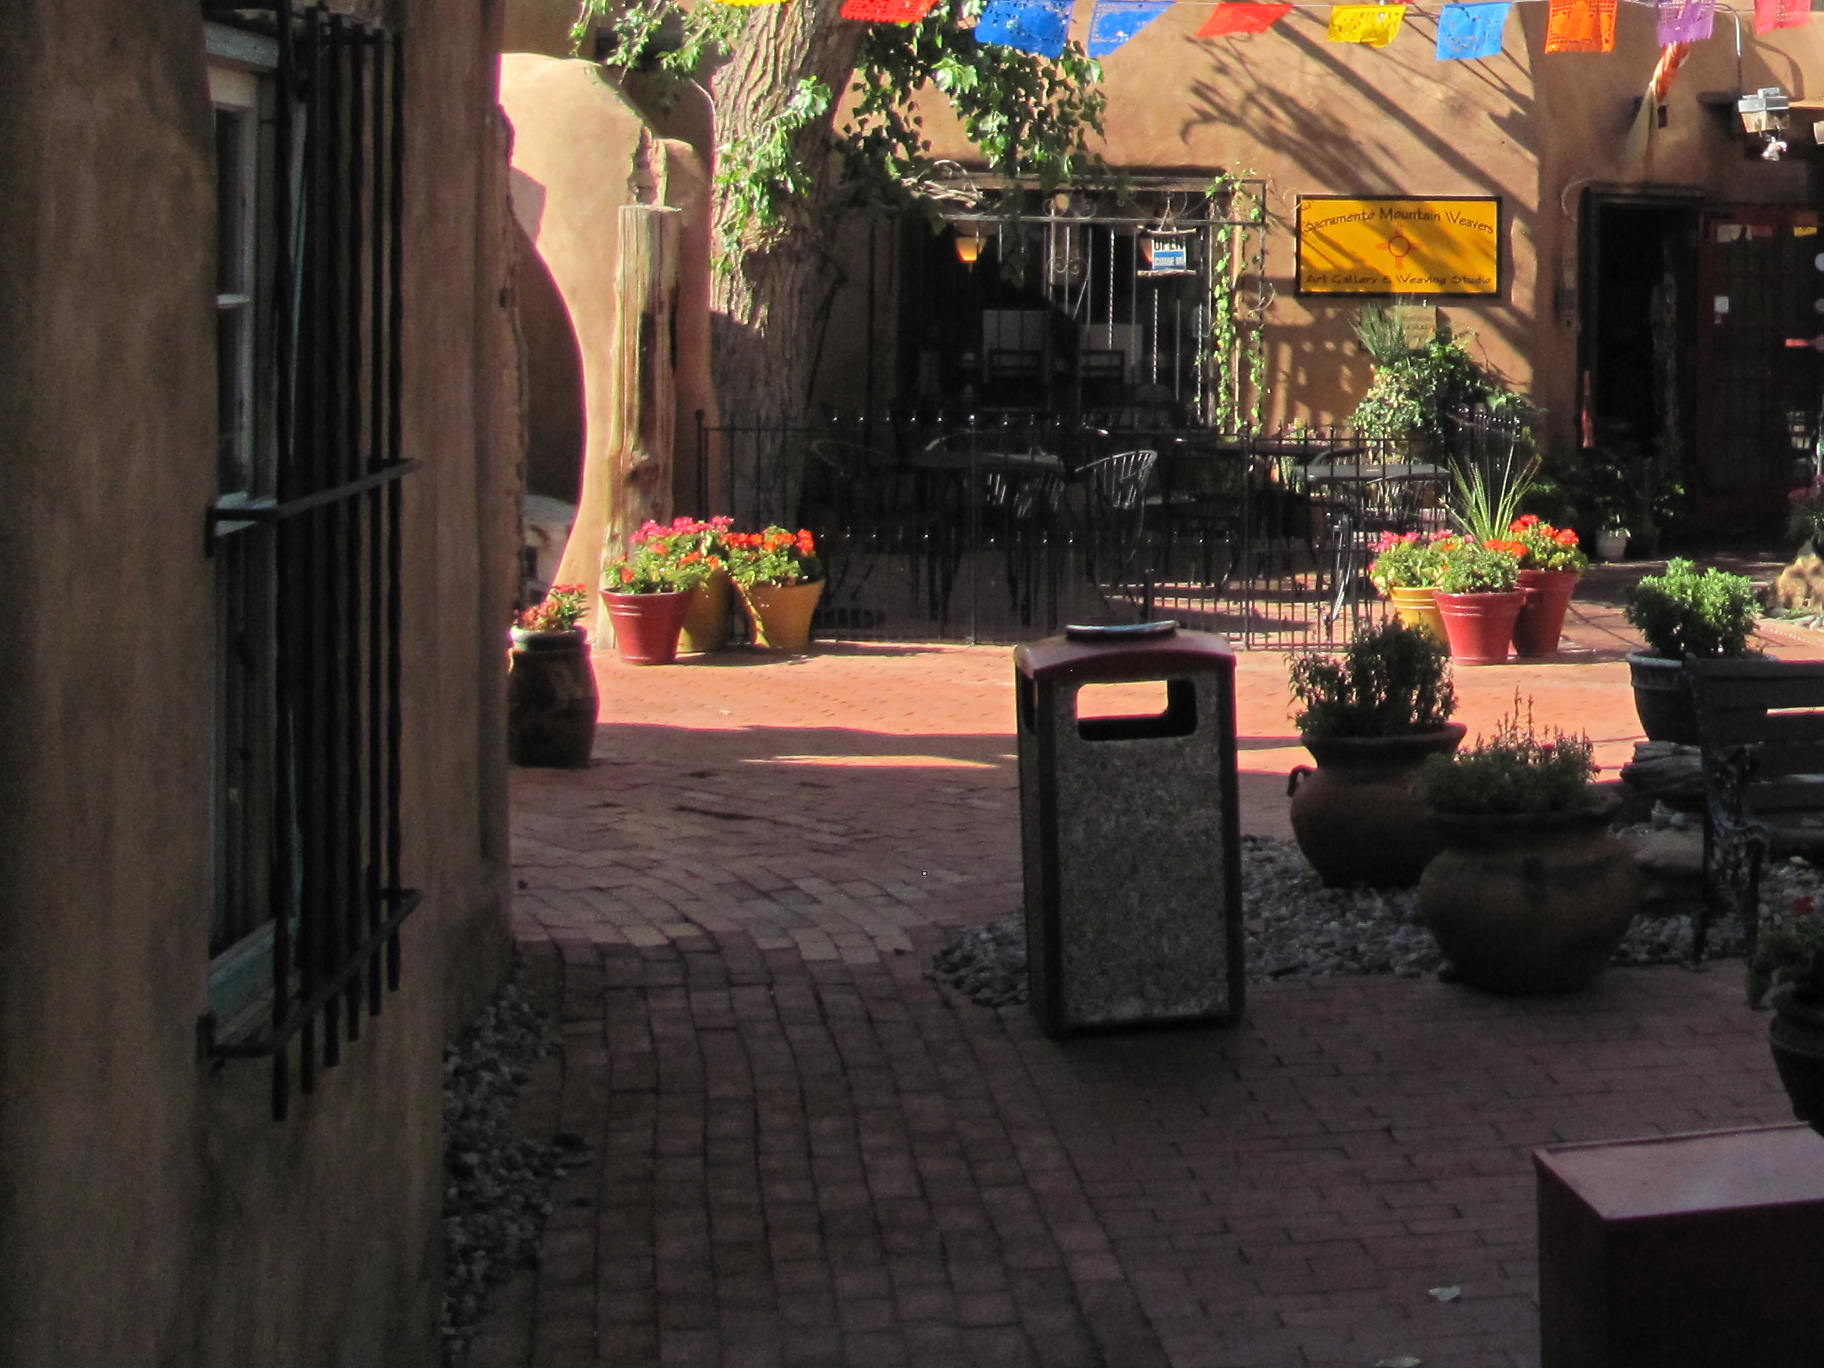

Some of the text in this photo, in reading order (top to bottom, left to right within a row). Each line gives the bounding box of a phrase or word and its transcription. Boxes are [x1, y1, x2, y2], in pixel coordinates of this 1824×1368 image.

[1303, 207, 1494, 234] Sacramento Mountain Weavers
[1305, 274, 1328, 284] Art
